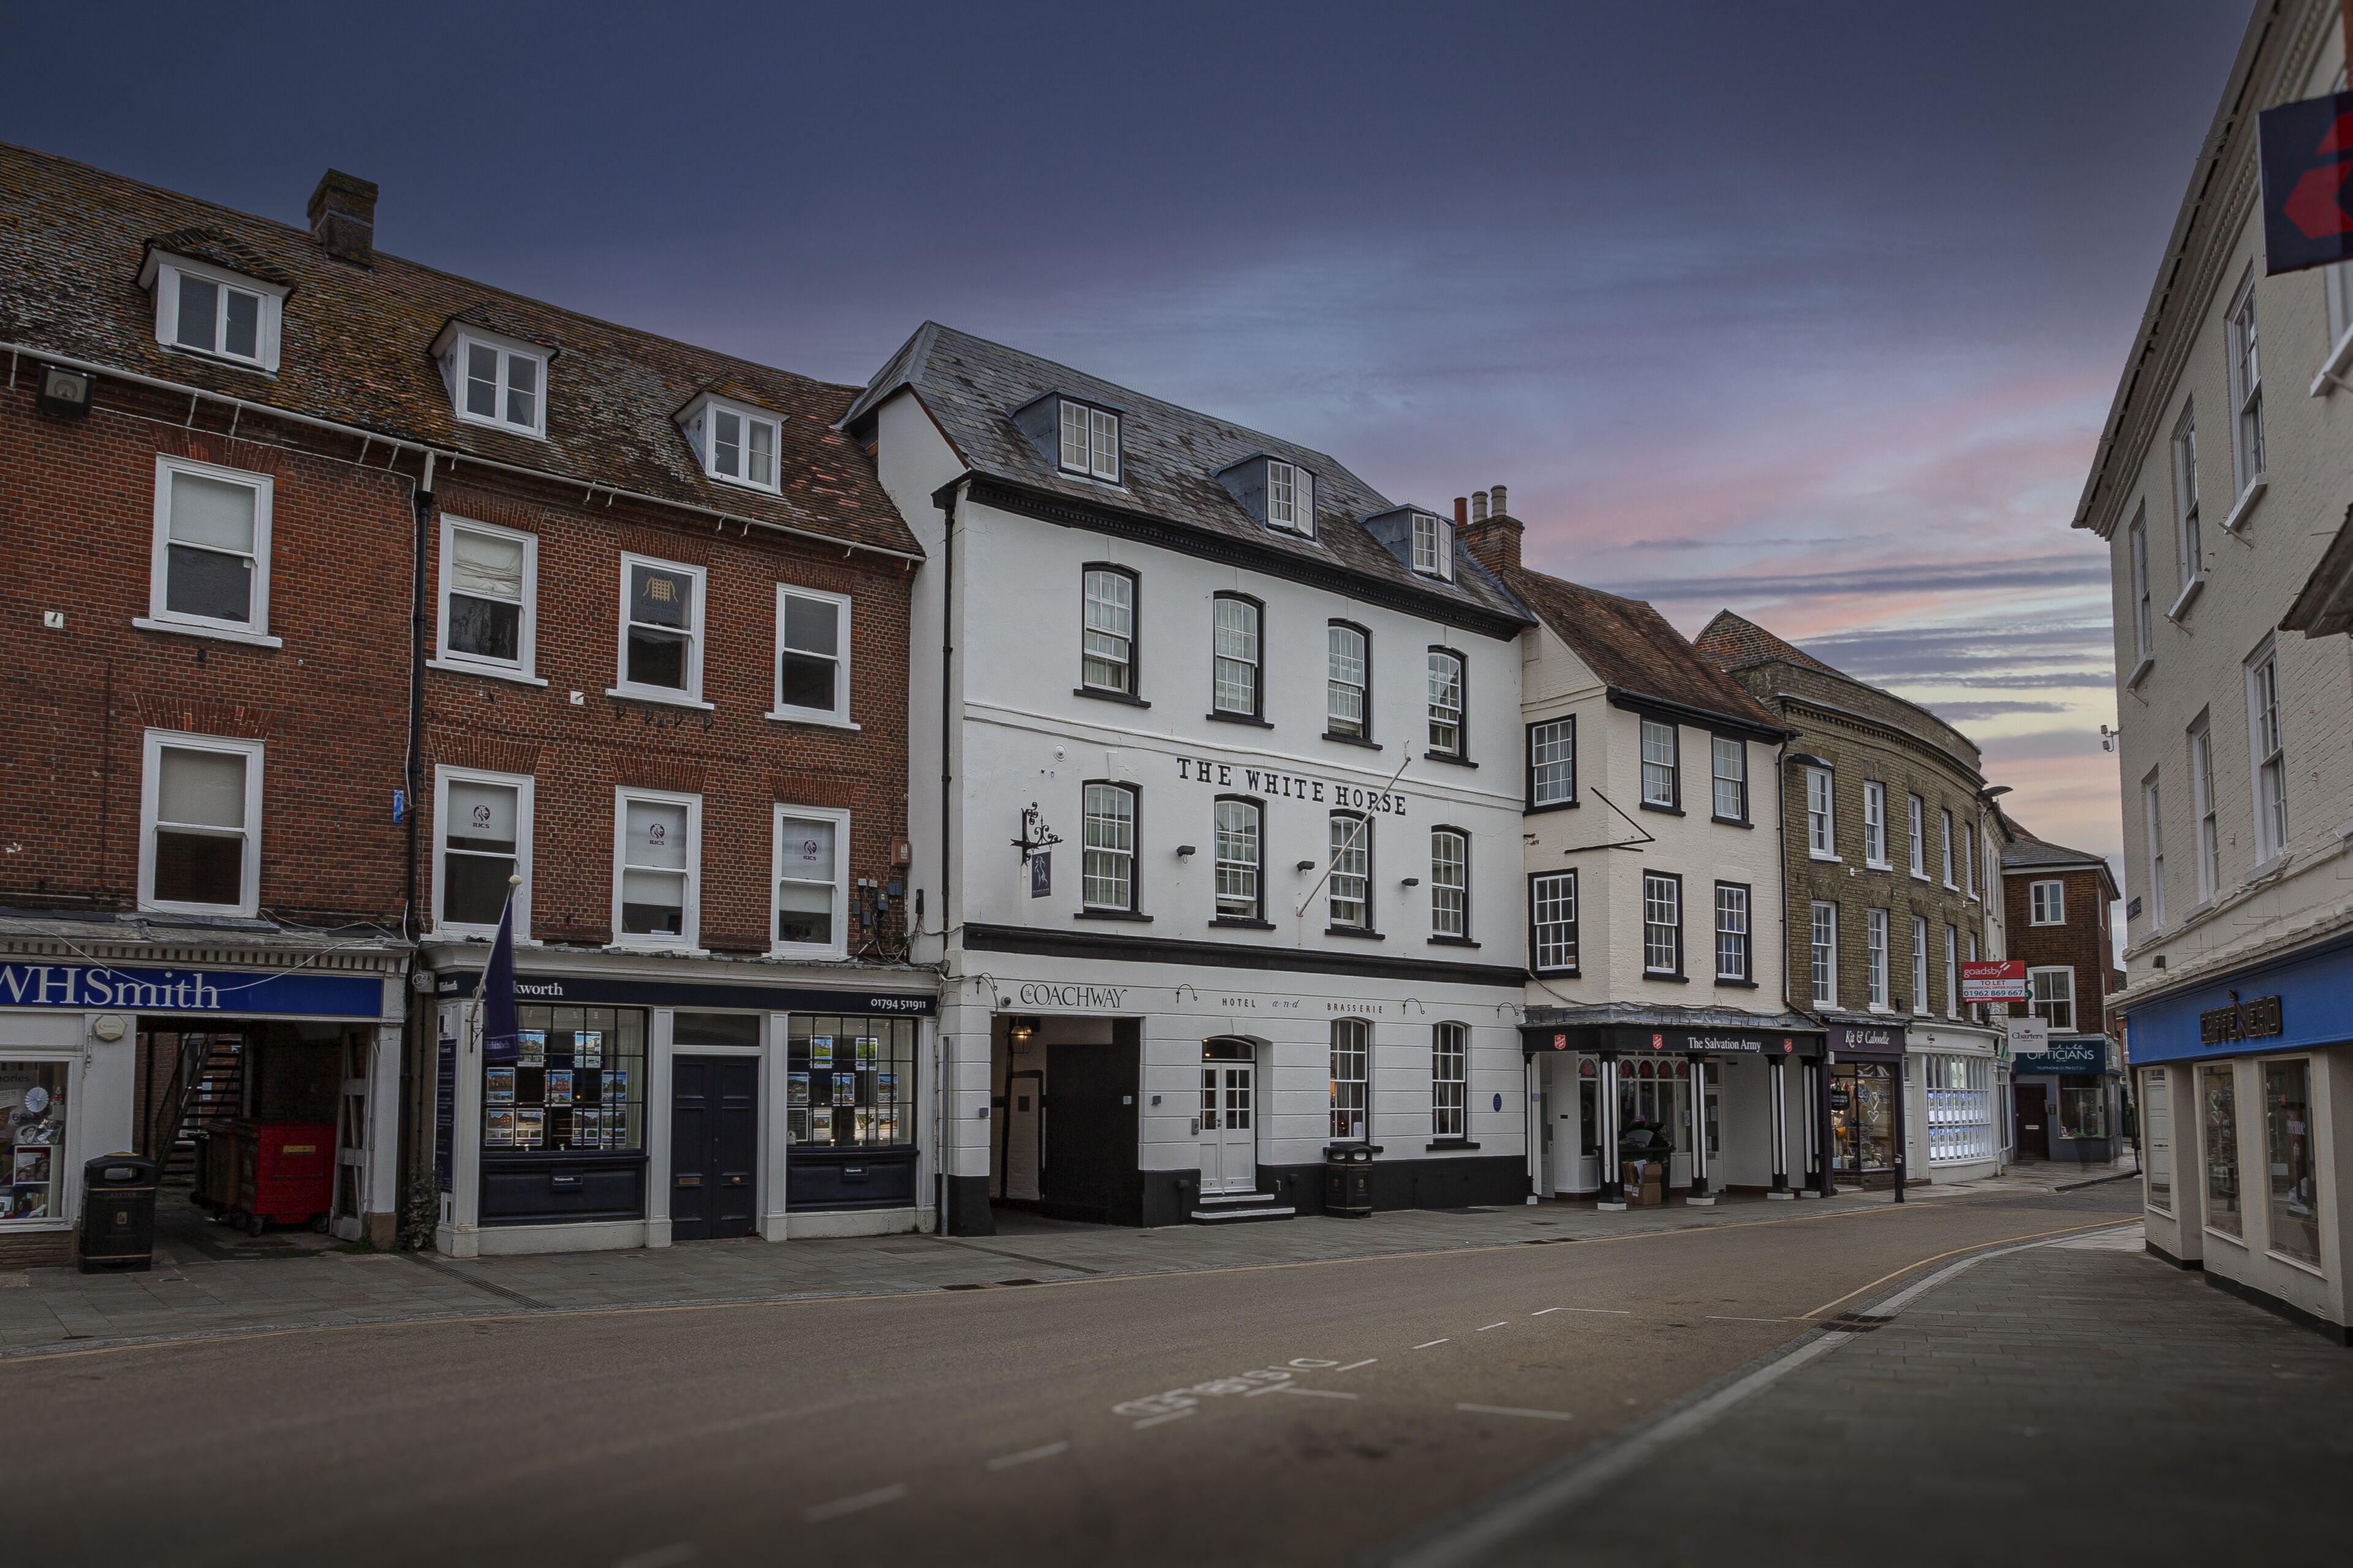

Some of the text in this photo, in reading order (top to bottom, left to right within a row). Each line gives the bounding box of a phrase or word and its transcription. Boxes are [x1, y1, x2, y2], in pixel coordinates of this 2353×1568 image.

[1176, 757, 1406, 816] THE WHITE HORSE
[1963, 966, 2003, 978] goadsby
[1020, 983, 1127, 1008] COACHWAY
[871, 998, 926, 1010] 01794 511911
[1222, 998, 1256, 1009] HOTEL
[1327, 1002, 1383, 1013] BRASSERIE
[1688, 1037, 1761, 1053] The Salvation Army
[1845, 1030, 1890, 1048] Kit & Caboodle
[2026, 1050, 2094, 1059] OPTICIANS
